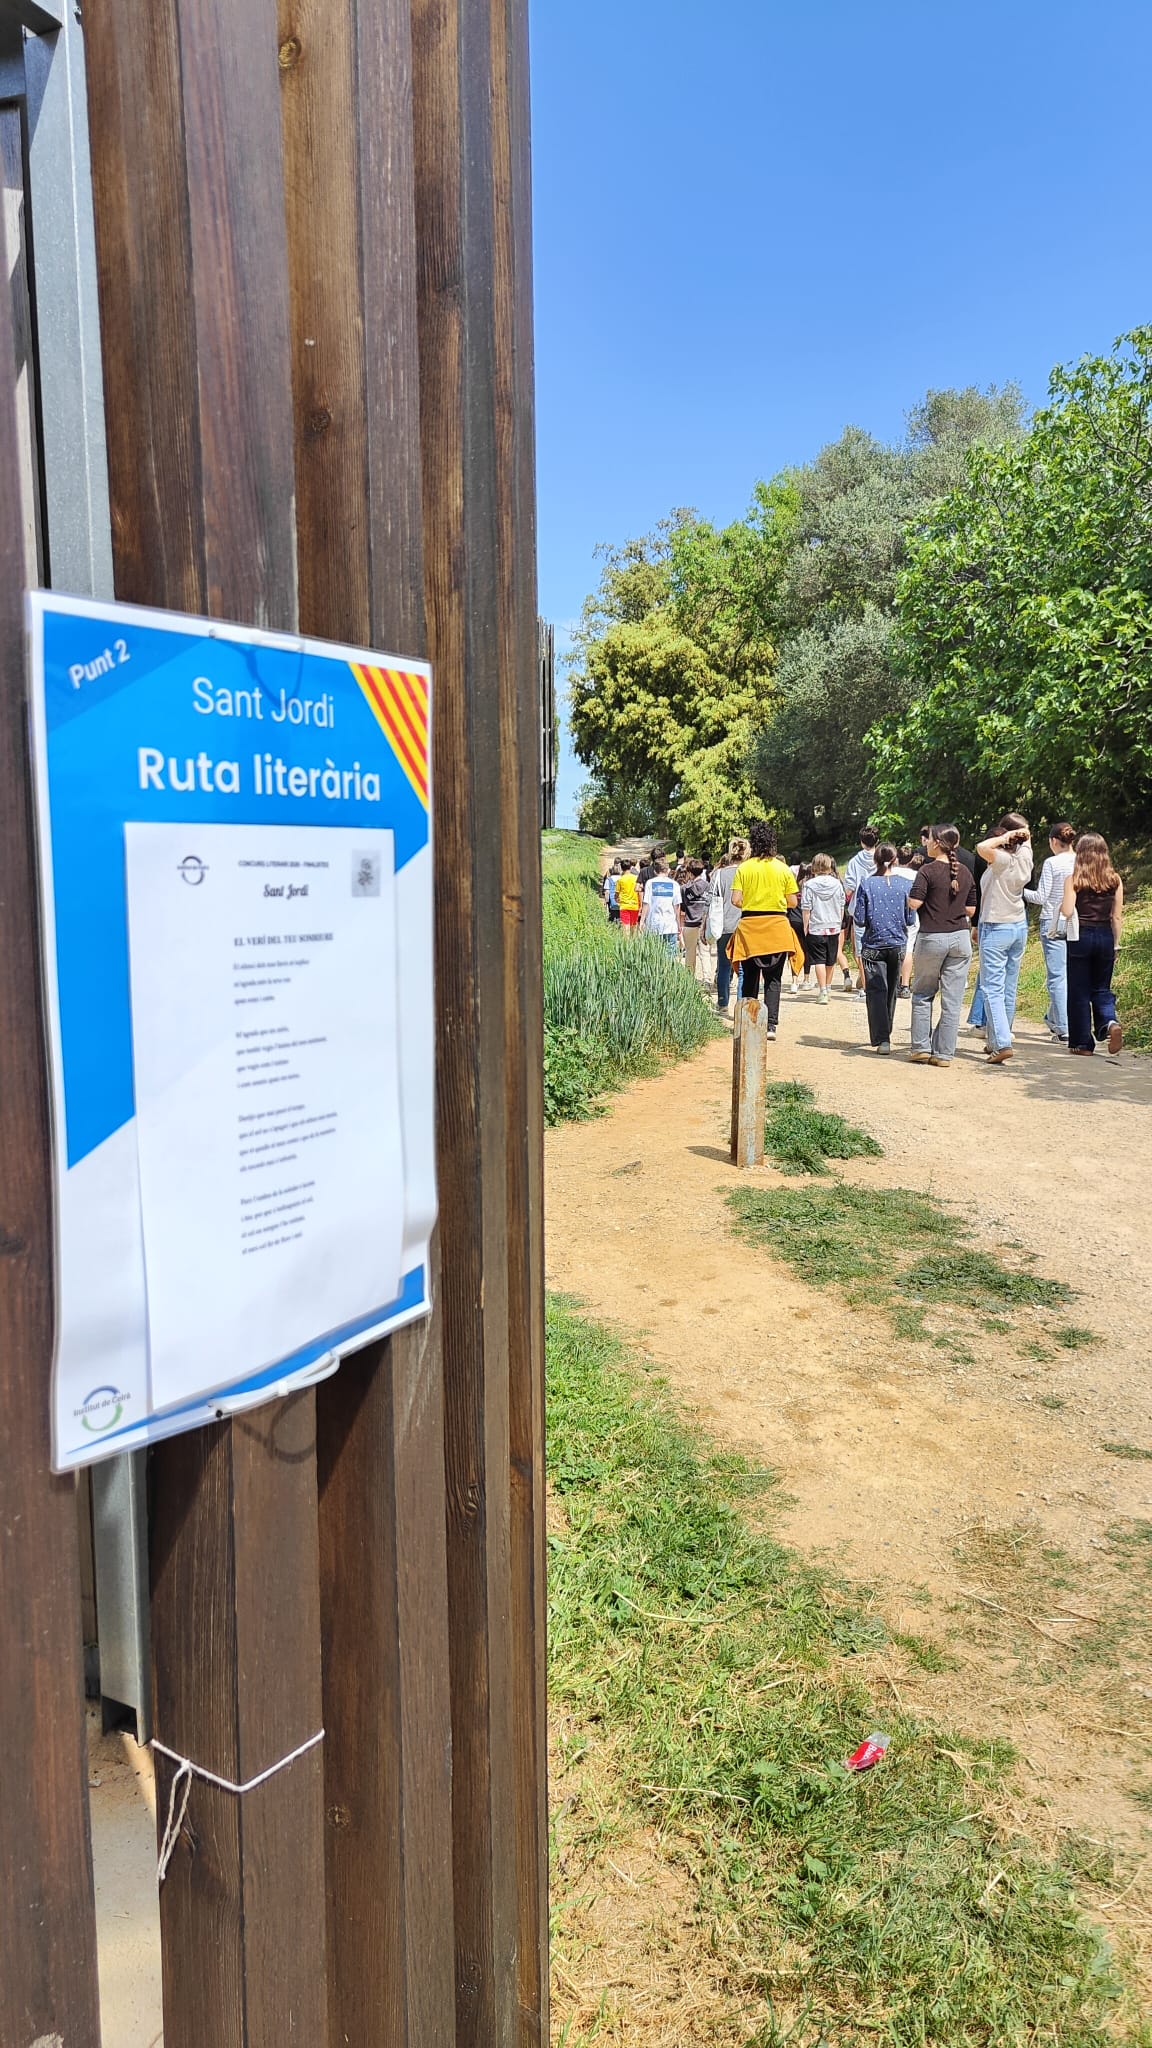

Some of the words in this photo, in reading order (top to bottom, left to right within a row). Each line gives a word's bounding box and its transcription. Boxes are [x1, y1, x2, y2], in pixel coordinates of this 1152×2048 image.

[70, 651, 114, 689] Punt
[115, 639, 131, 664] 2
[193, 676, 263, 720] Sant
[271, 687, 335, 728] Jordi
[137, 746, 241, 795] Ruta
[254, 752, 381, 801] literària
[263, 884, 284, 898] Sant
[286, 884, 309, 900] Jordi
